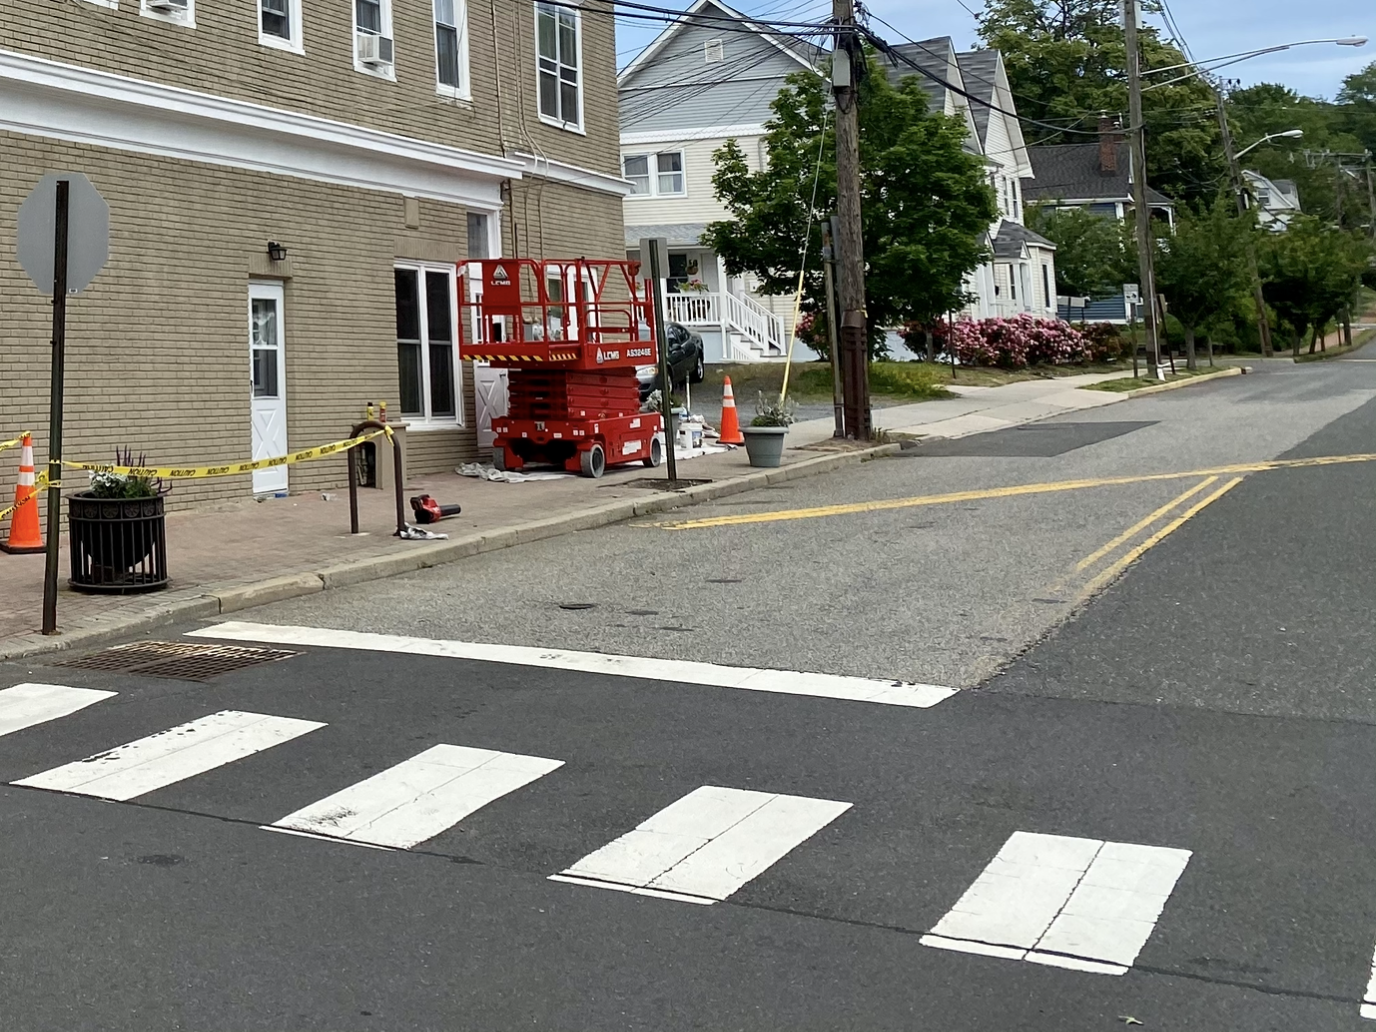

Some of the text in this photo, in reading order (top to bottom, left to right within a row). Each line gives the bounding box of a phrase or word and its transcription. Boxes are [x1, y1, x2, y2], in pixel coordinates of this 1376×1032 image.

[239, 462, 259, 472] CAUTION
[268, 457, 287, 466] CAUTION
[295, 451, 313, 461] CAUTION
[320, 445, 336, 455] CAUTION
